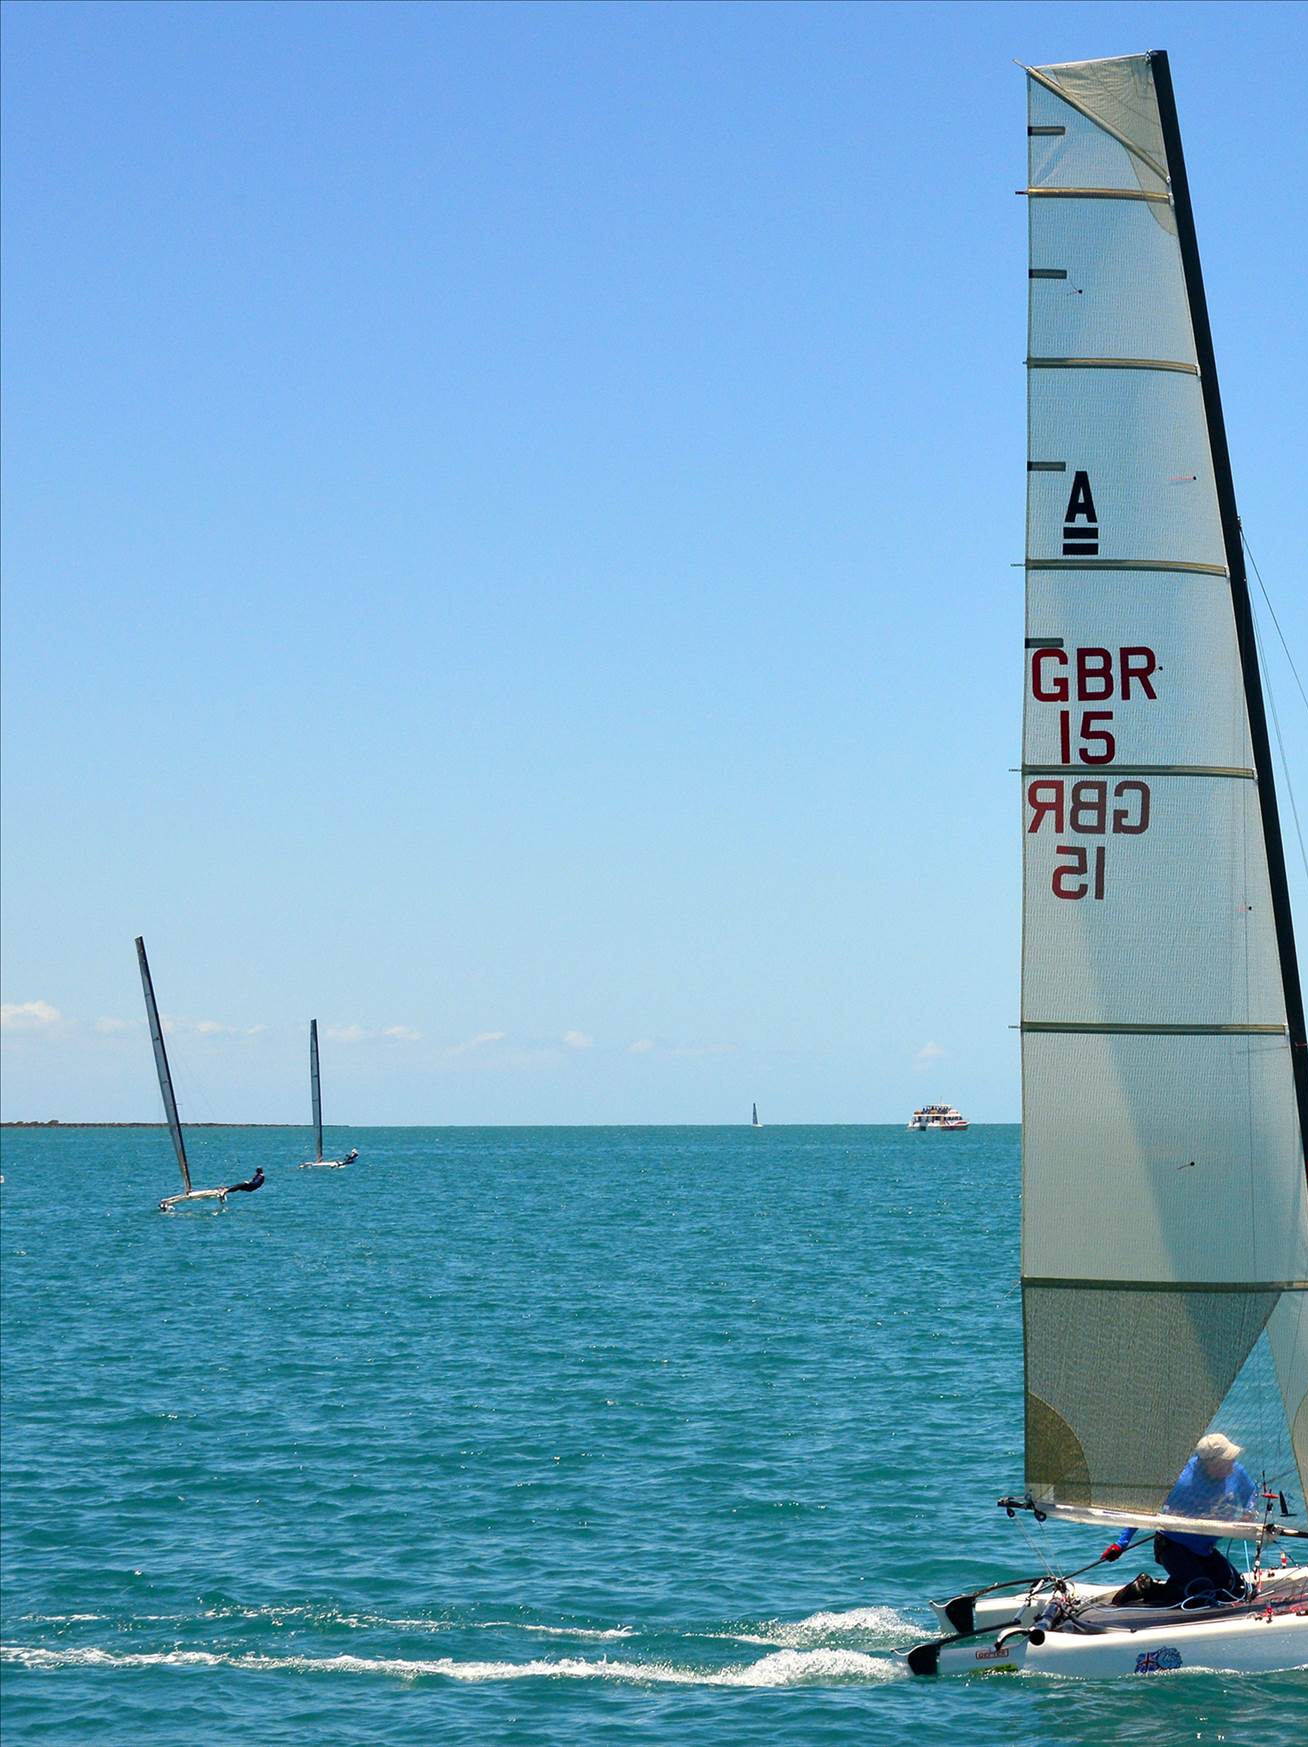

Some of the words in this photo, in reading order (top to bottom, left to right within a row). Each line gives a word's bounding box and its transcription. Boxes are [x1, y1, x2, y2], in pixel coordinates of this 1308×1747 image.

[1064, 471, 1098, 523] A
[1031, 647, 1157, 702] GBR
[1060, 711, 1115, 764] 15
